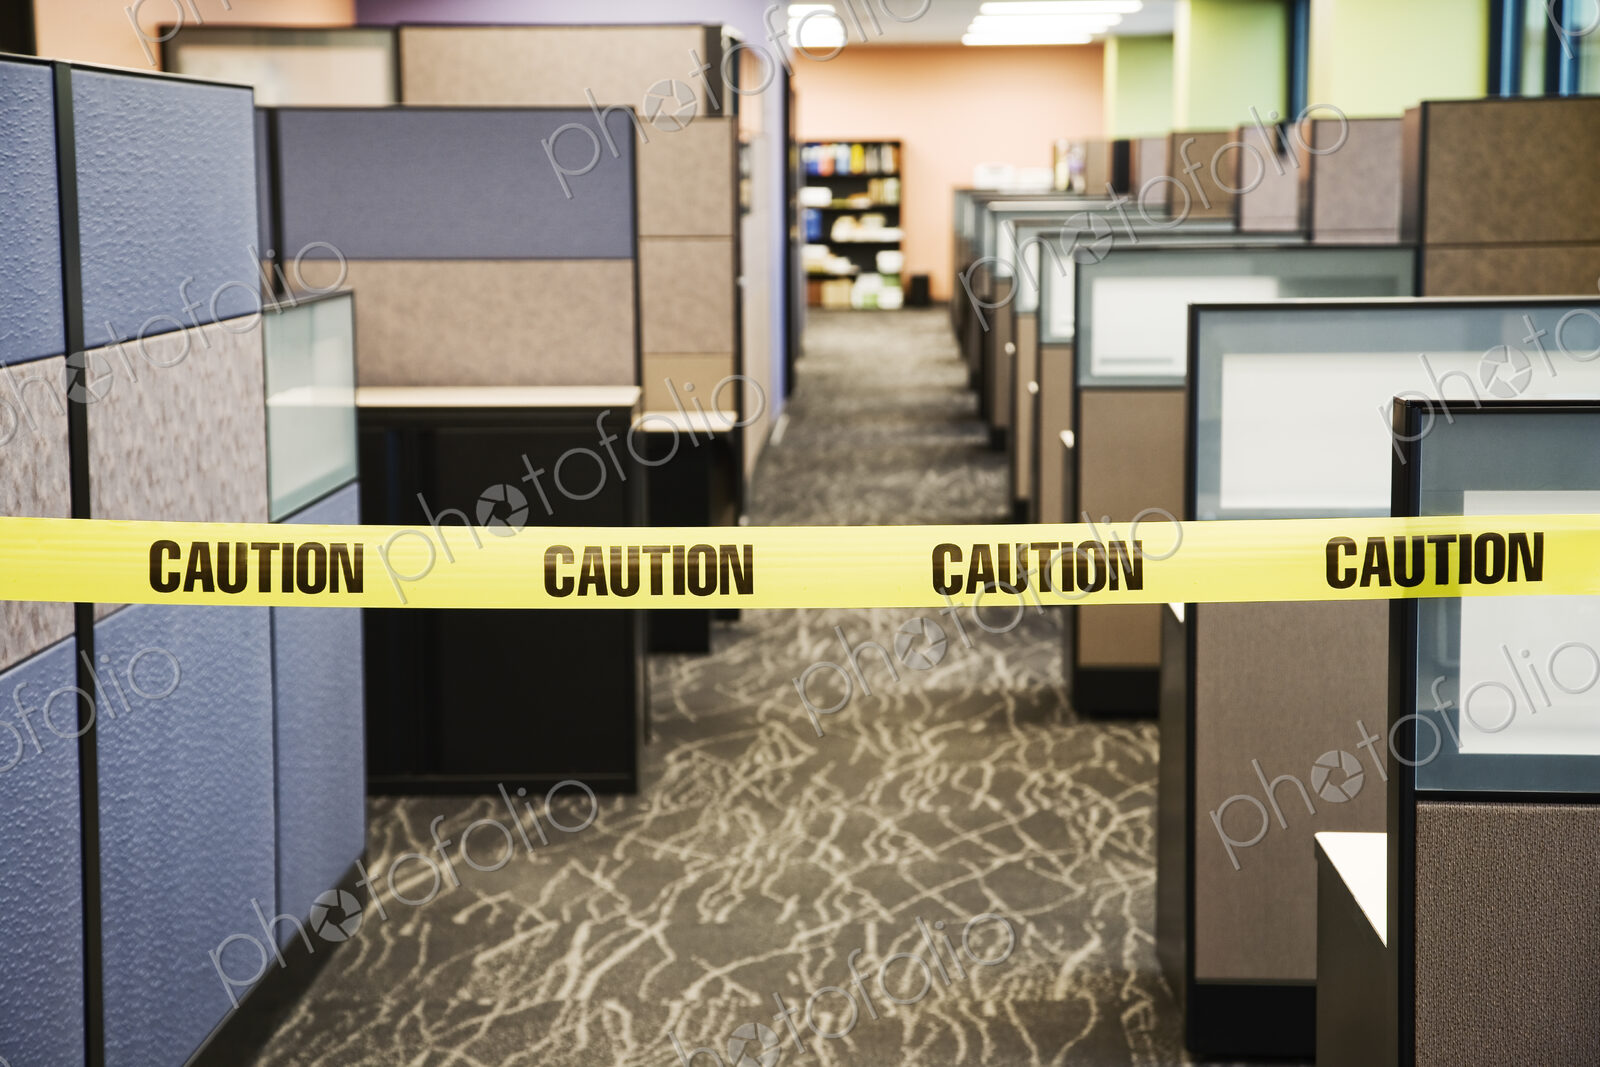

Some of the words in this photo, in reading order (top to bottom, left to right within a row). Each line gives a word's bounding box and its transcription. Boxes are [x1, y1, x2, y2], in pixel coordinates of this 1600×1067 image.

[149, 540, 363, 594] CAUTION
[544, 544, 753, 597] CAUTION
[932, 540, 1143, 595] CAUTION
[1325, 532, 1543, 589] CAUTION
